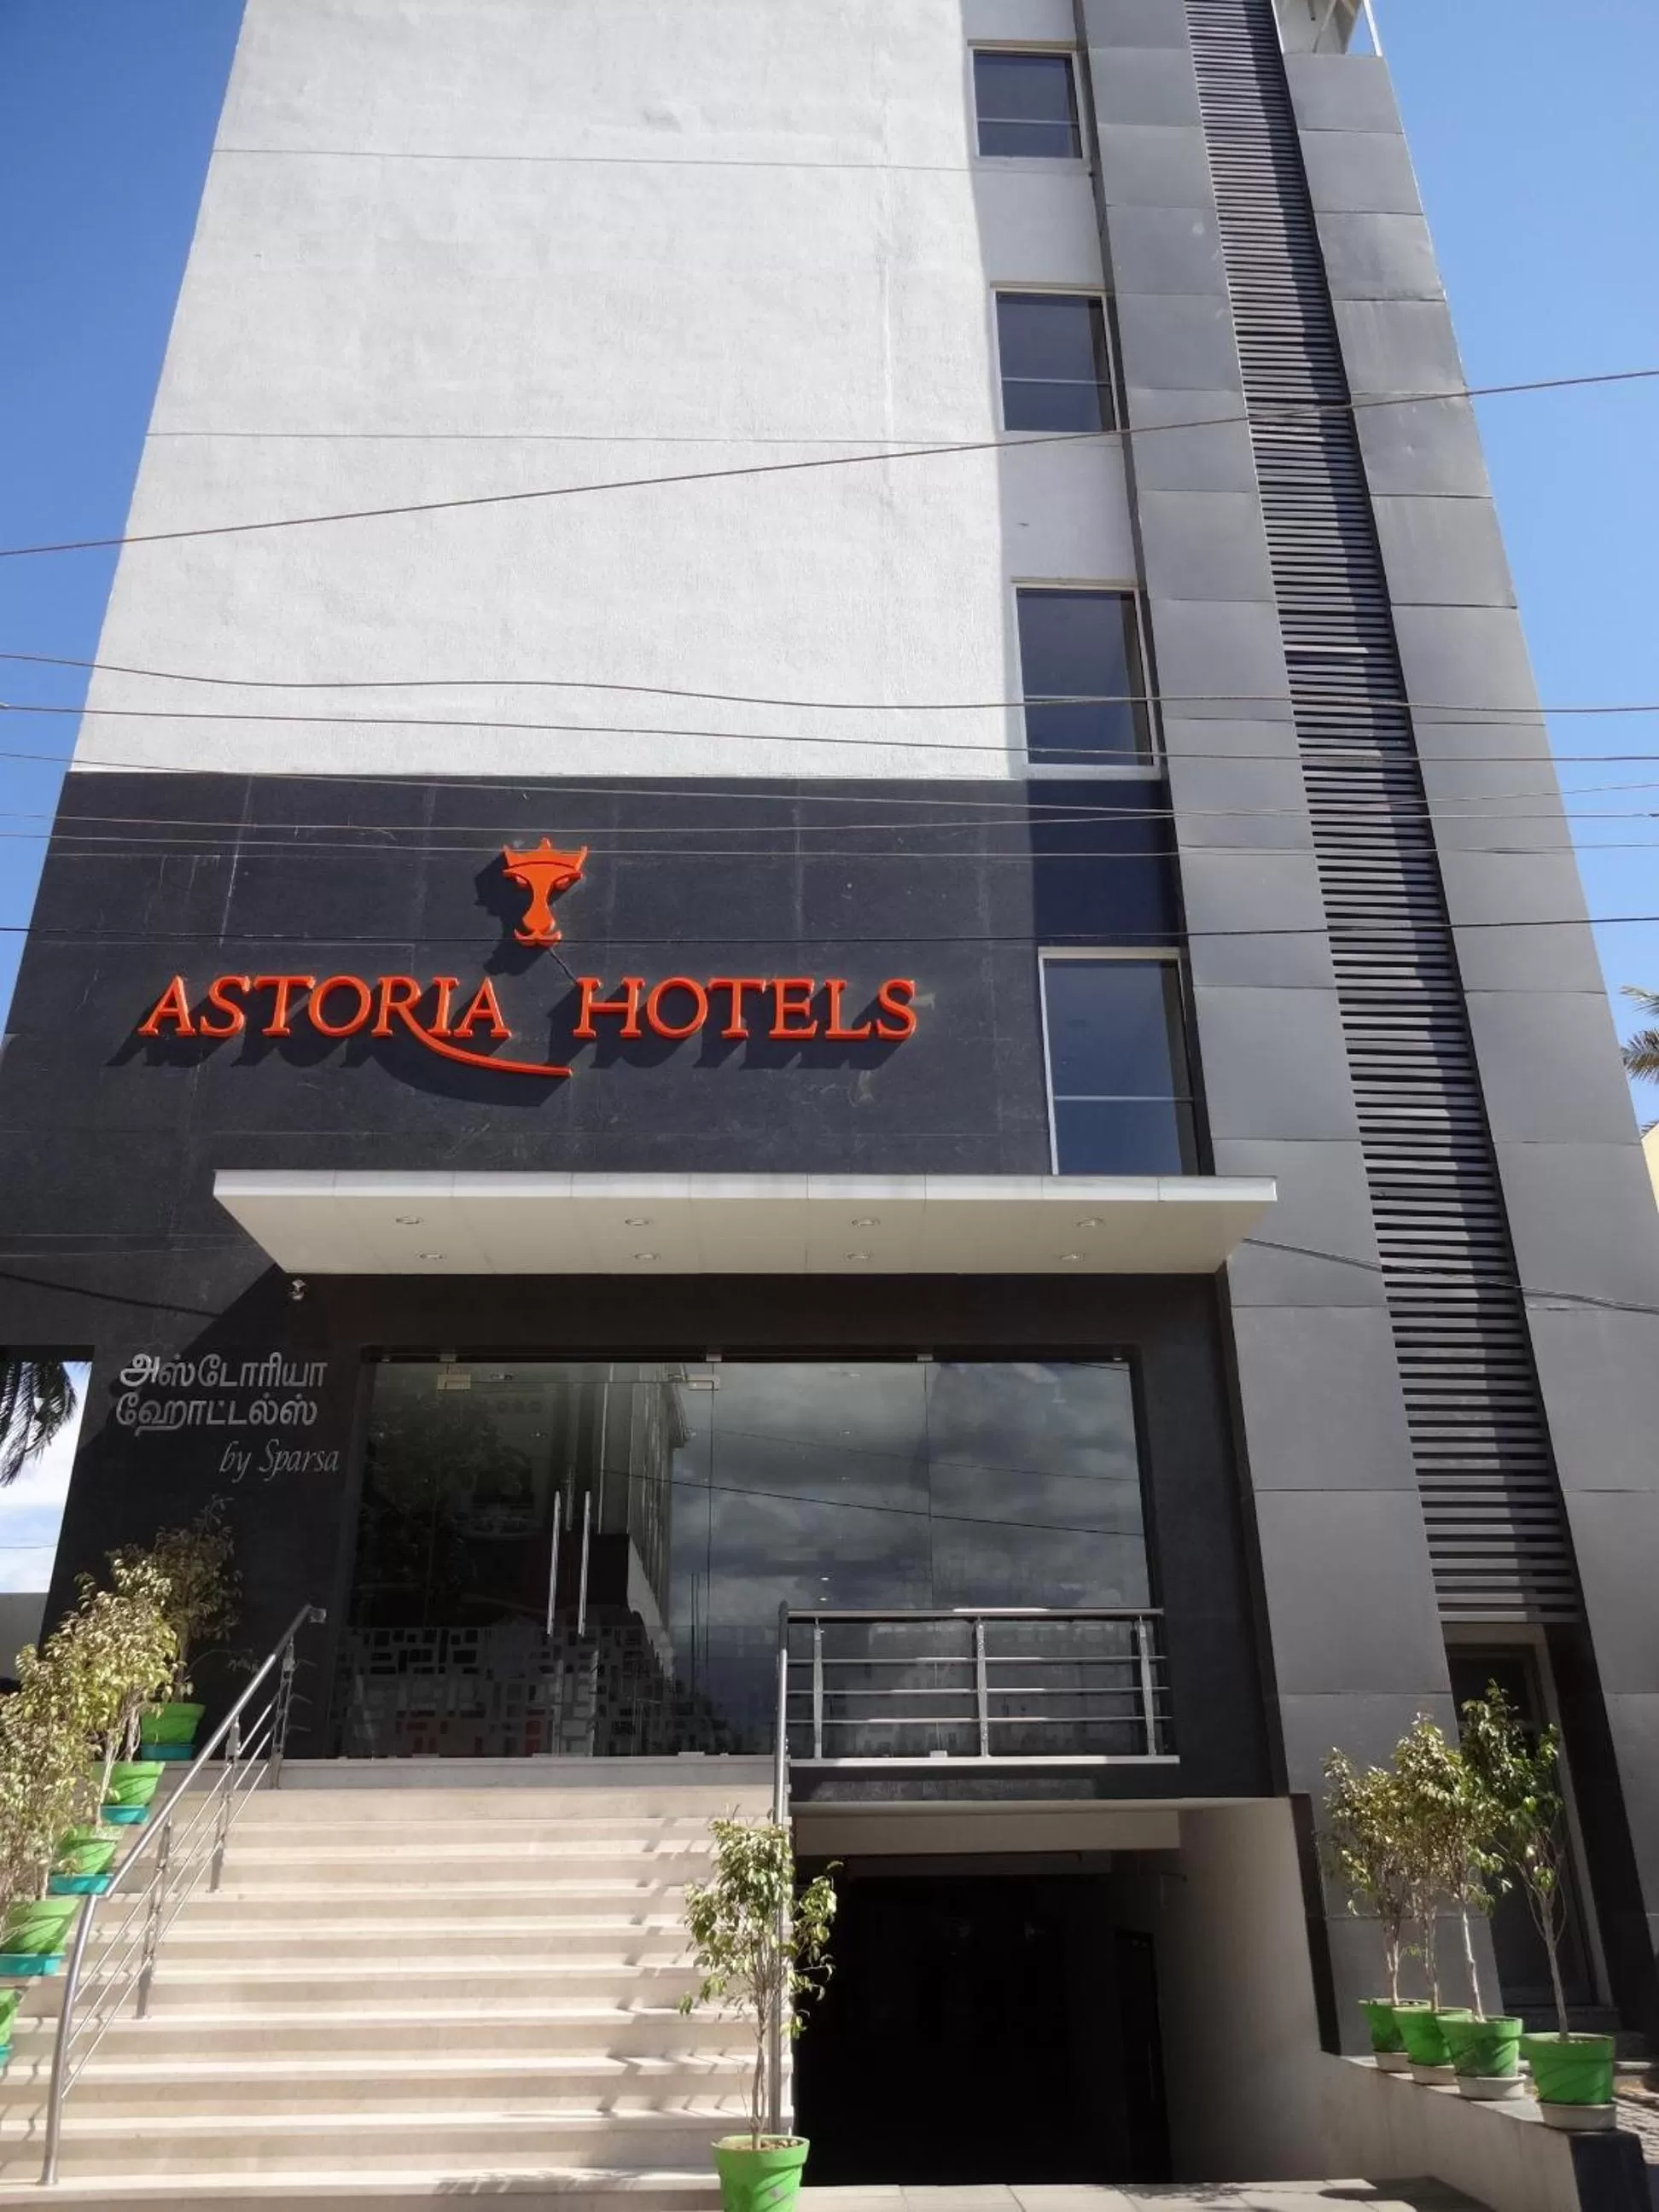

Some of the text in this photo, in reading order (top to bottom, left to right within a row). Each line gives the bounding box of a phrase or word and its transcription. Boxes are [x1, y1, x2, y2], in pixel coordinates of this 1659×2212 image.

[139, 975, 918, 1077] ASTORIA HOTELS
[119, 1352, 328, 1388] அஸ்டோரியா
[116, 1391, 318, 1437] ஹோட்டல்ஸ்
[218, 1439, 340, 1483] by Sparsa
